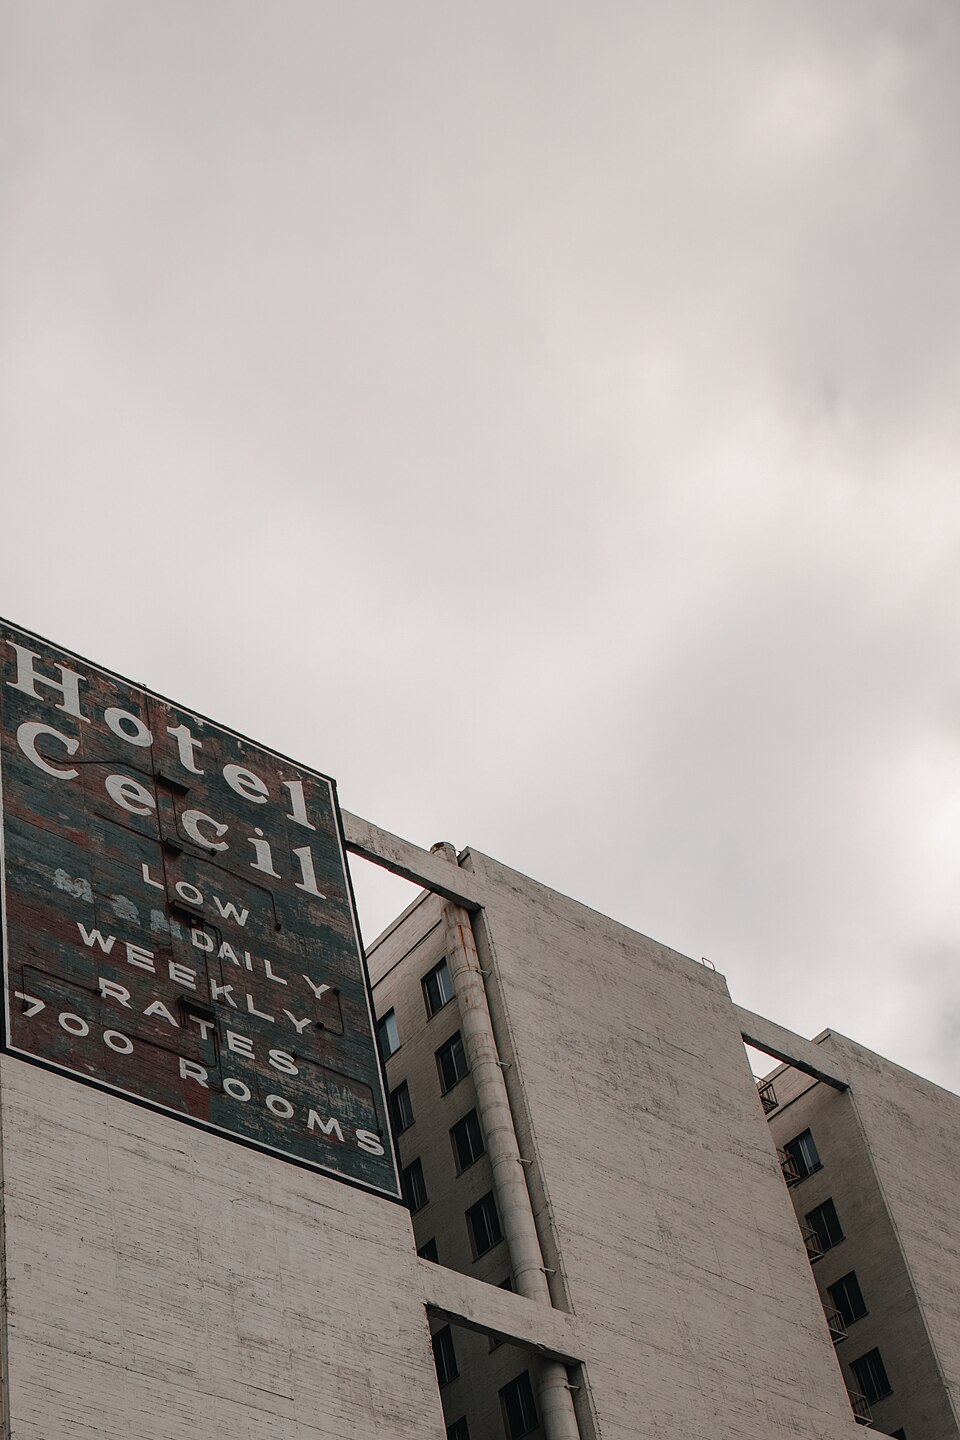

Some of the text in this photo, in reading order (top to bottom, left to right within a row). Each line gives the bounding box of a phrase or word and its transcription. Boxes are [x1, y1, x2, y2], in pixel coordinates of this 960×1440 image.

[6, 640, 316, 831] Hotel
[17, 721, 326, 900] Cecil
[142, 863, 248, 927] LOW
[76, 921, 312, 1034] WEEKLY
[191, 928, 330, 999] DAILY
[14, 990, 385, 1156] 700 ROOMS
[98, 976, 299, 1076] RATES
